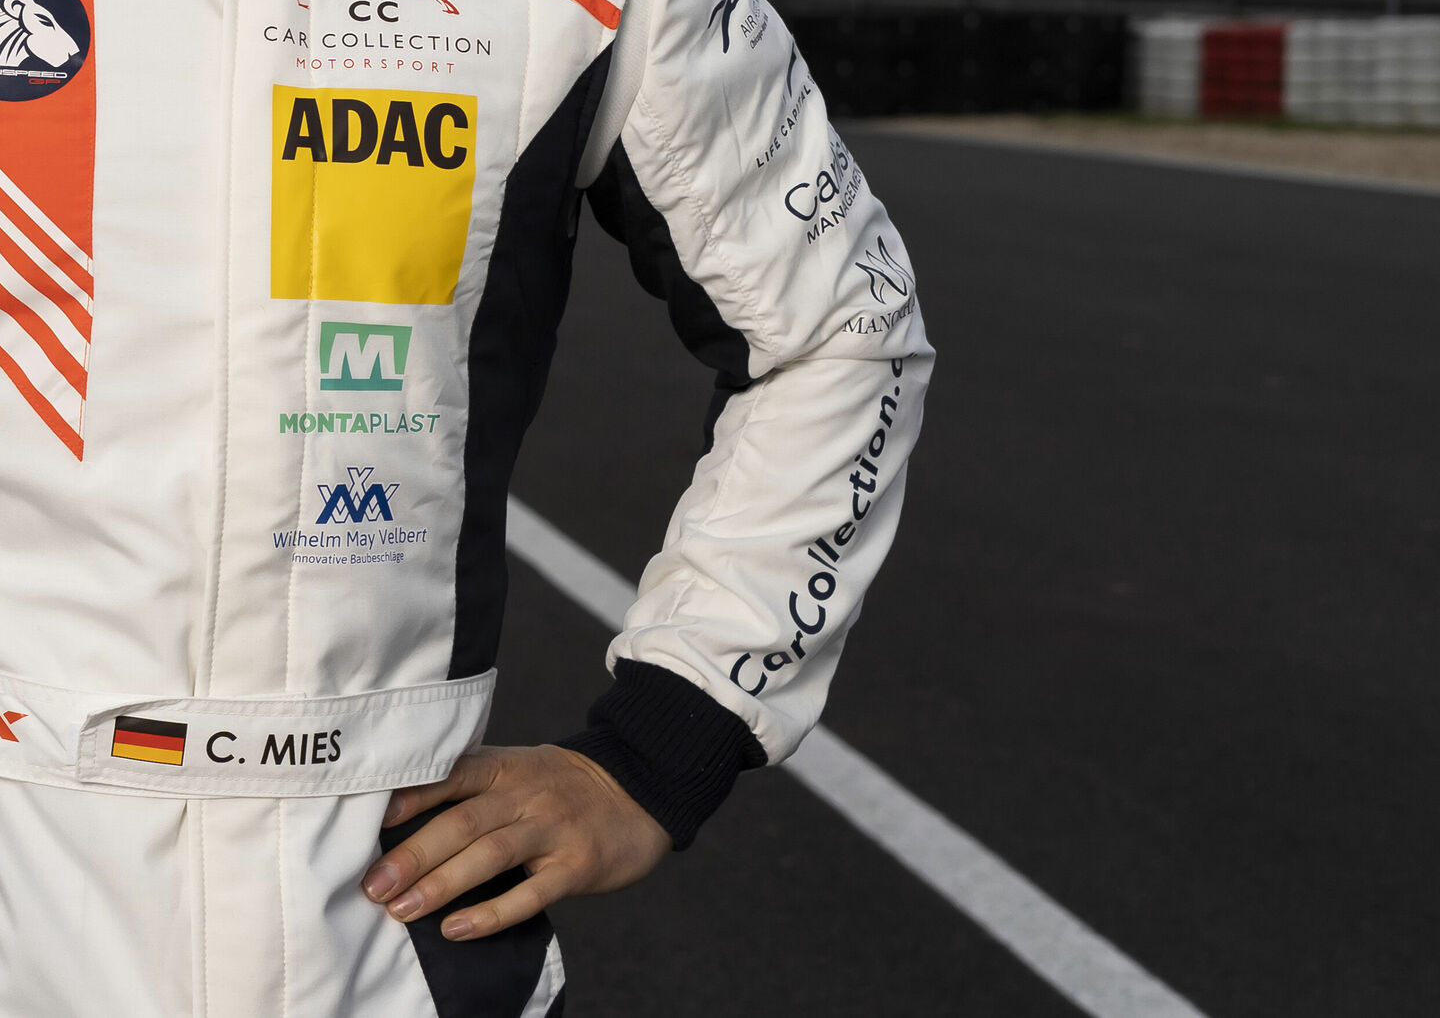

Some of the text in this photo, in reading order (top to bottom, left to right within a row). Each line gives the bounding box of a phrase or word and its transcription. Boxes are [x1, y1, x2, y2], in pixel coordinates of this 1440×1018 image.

[348, 0, 399, 23] CC
[263, 26, 491, 56] CAR COLLECTION
[296, 58, 456, 73] MOTORSPORT
[282, 97, 469, 170] ADAC
[756, 84, 812, 168] LIFE CAPITAL
[280, 413, 440, 434] MONTAPLAST
[273, 528, 427, 550] Wilhelm May Velbert
[292, 552, 347, 565] Innovative
[205, 729, 341, 765] C. MIES
